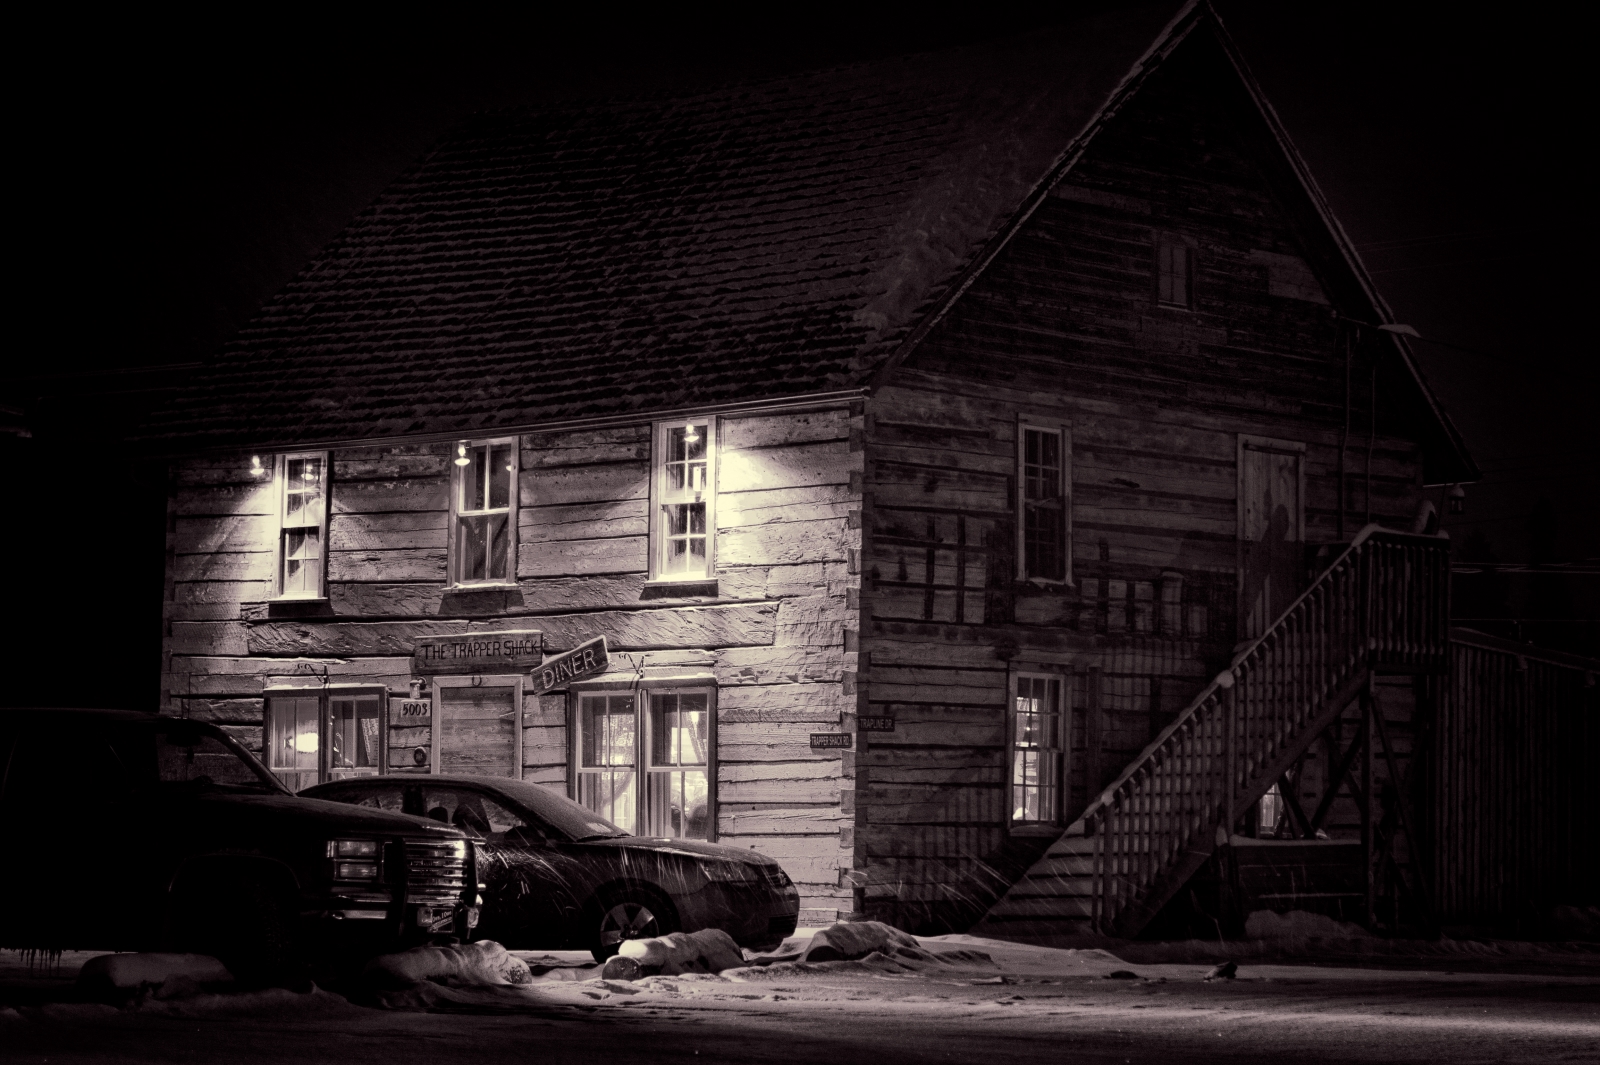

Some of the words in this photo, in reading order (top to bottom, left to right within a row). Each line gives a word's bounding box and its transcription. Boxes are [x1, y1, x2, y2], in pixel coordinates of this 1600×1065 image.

[421, 643, 447, 660] THE
[451, 641, 501, 659] TRAPPER
[503, 639, 538, 656] SHACK
[541, 648, 597, 690] DINER
[811, 735, 829, 746] TRAPPER
[829, 735, 843, 746] SHACK
